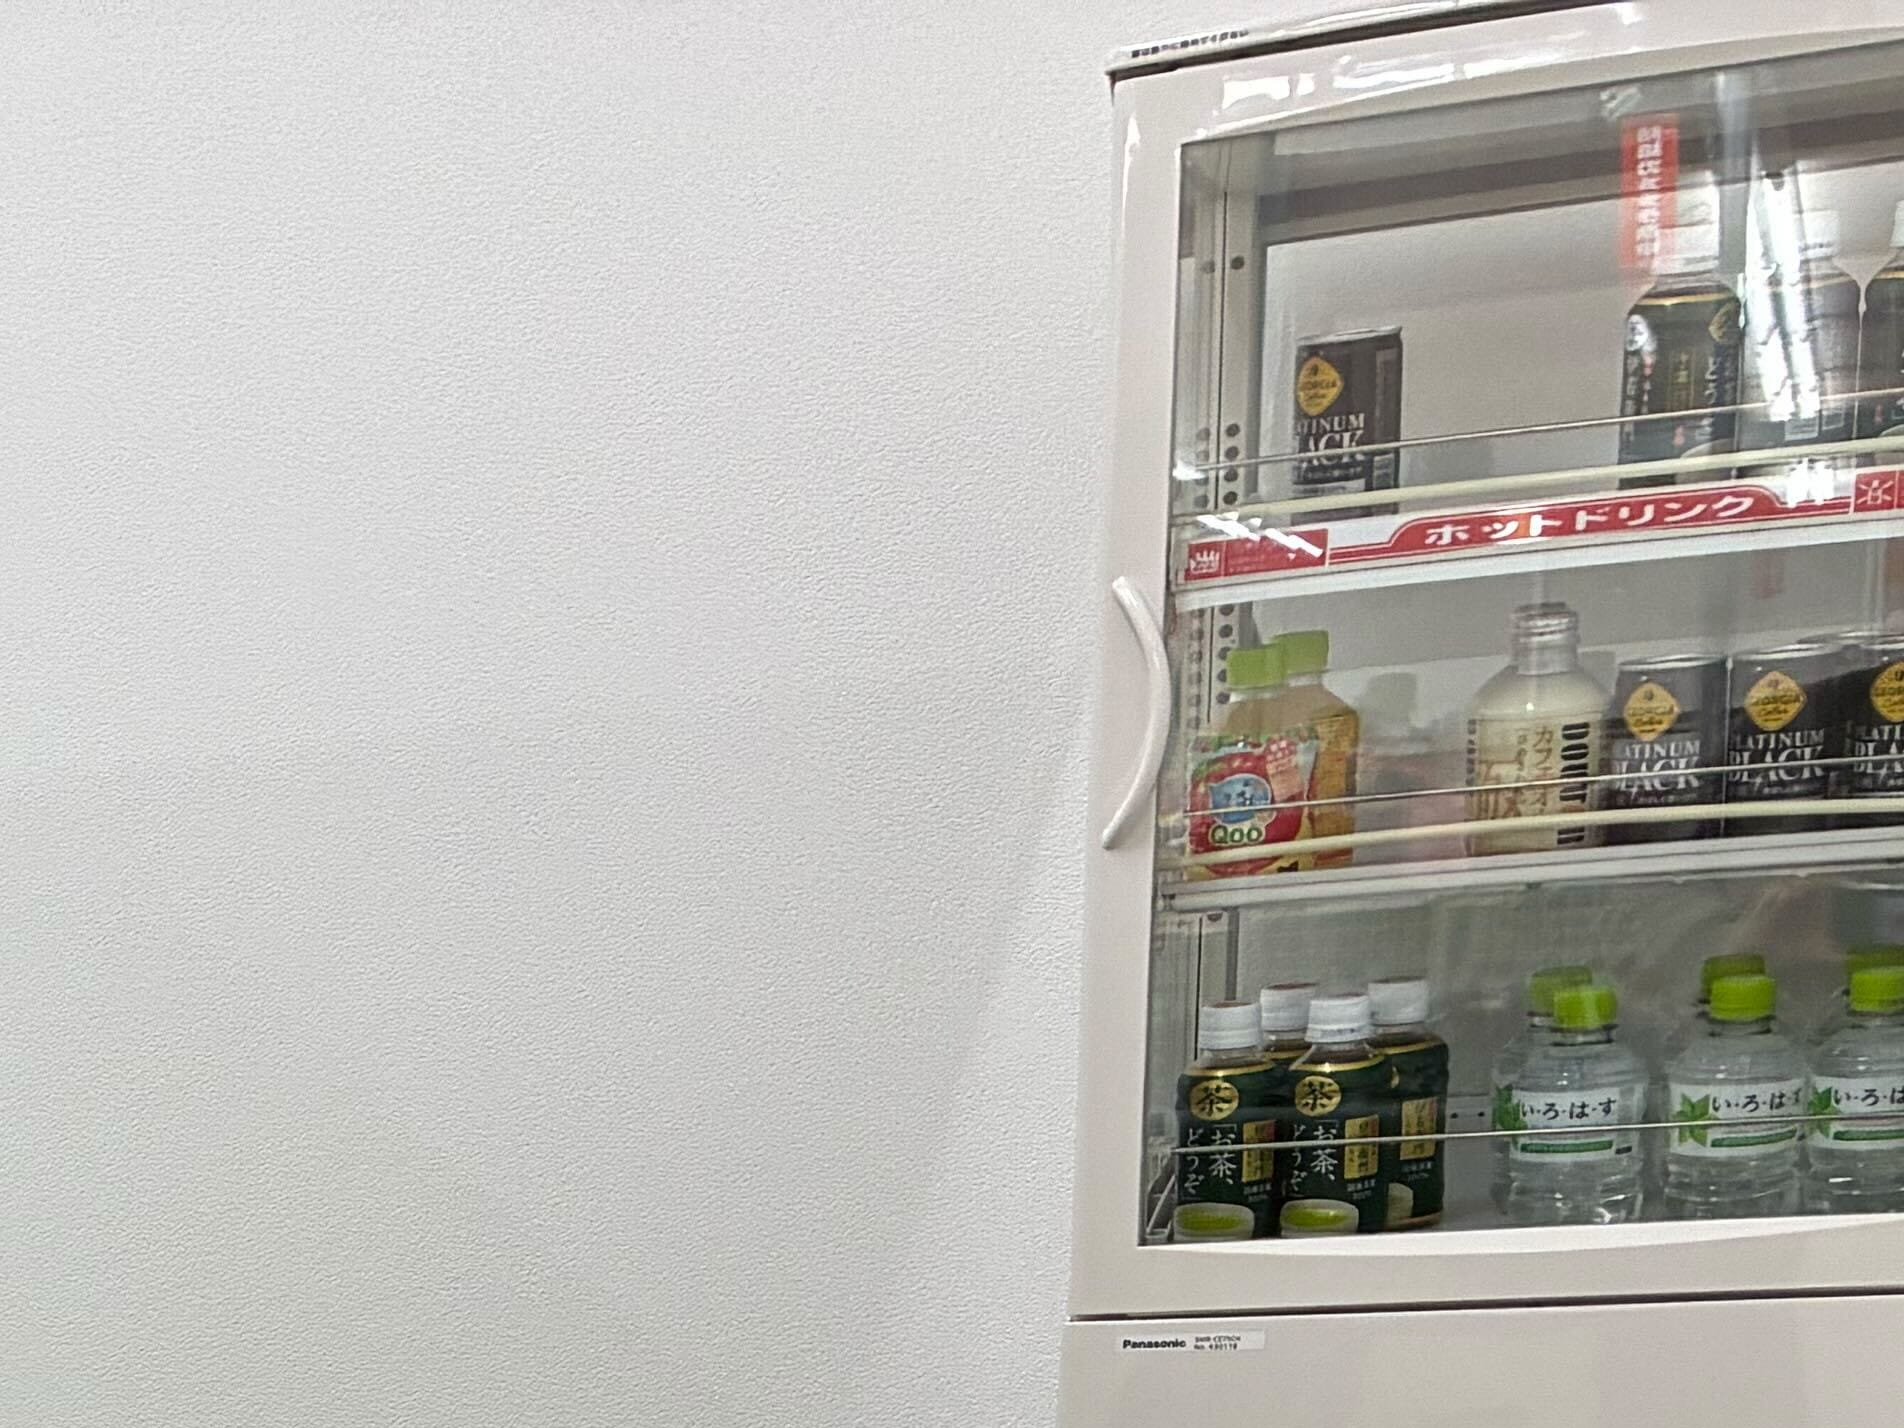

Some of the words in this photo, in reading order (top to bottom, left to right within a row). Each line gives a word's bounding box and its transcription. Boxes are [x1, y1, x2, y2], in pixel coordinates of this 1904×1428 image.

[1425, 493, 1757, 548] ホットドリンク
[1196, 1084, 1236, 1117] 茶
[1301, 1080, 1337, 1112] 茶
[1122, 1338, 1187, 1350] Panasonic
